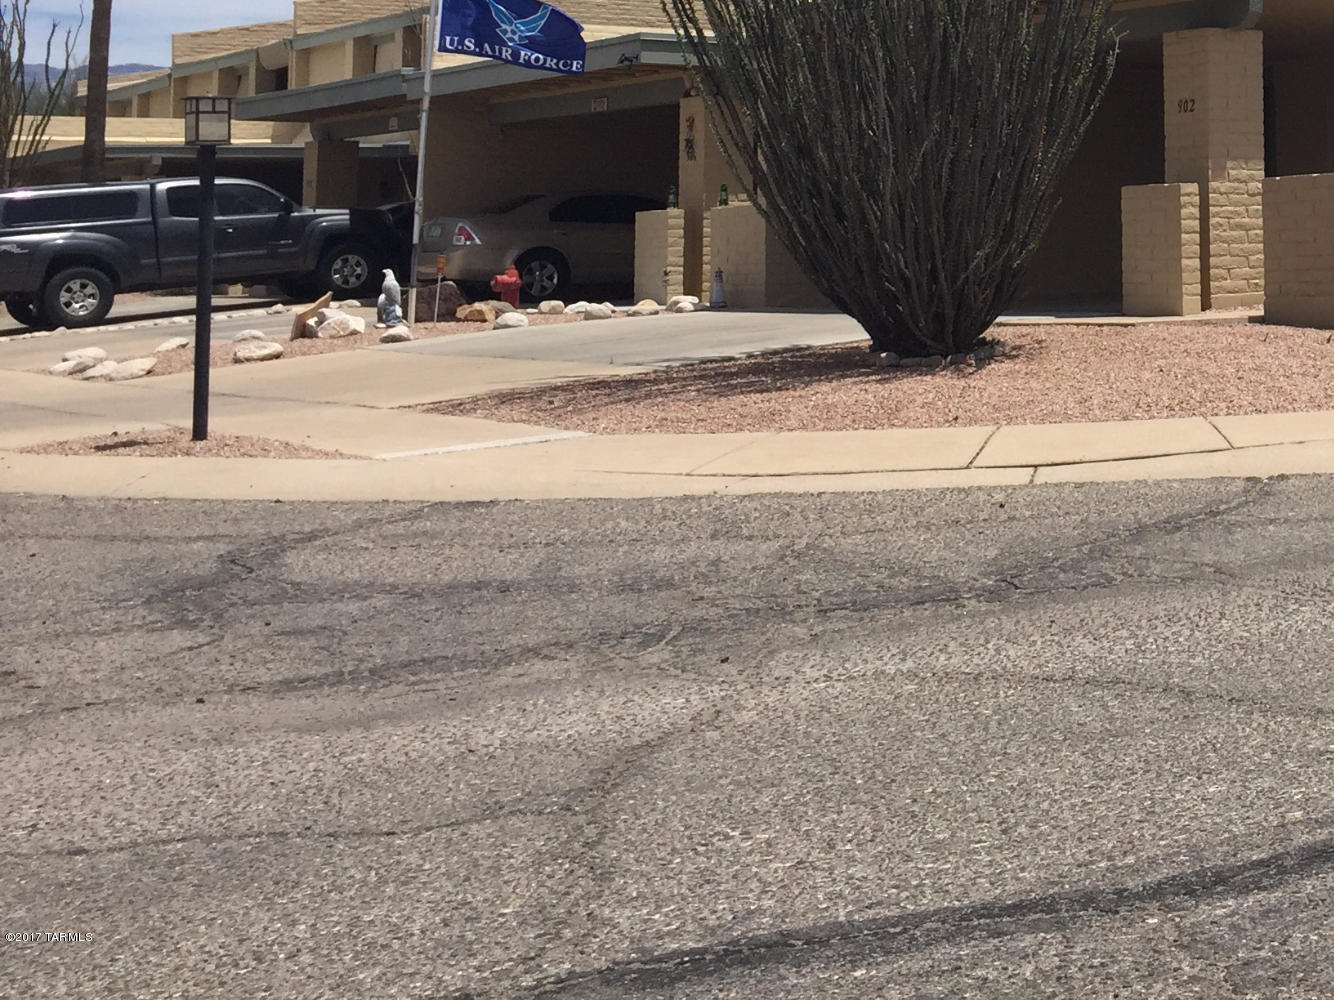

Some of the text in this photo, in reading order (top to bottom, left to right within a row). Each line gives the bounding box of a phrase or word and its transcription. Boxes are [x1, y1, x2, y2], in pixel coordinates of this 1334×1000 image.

[444, 35, 583, 72] U.S. AIR FORCE
[1177, 98, 1196, 113] 902
